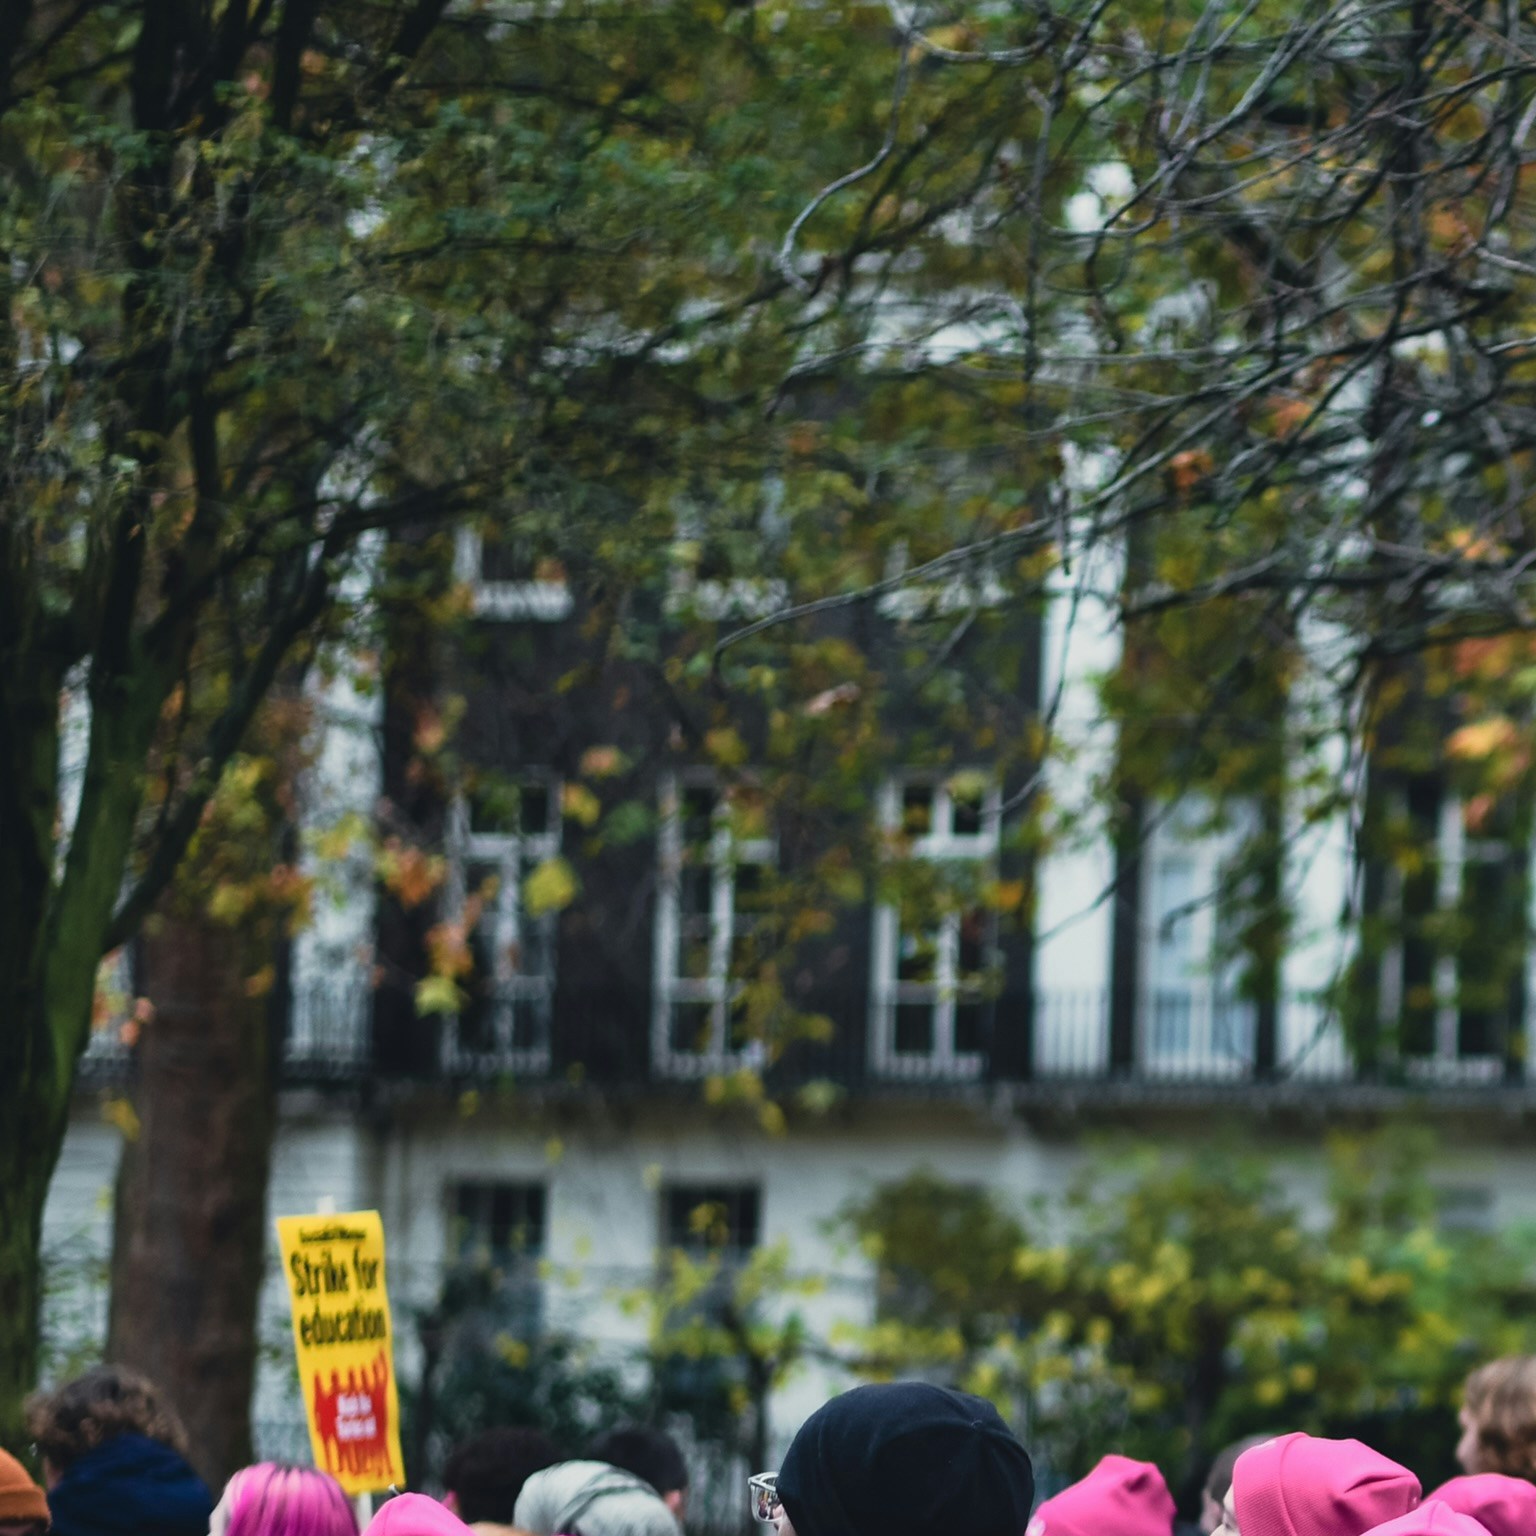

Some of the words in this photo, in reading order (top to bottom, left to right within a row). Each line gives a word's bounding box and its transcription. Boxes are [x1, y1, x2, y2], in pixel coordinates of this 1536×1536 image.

[290, 1247, 349, 1297] Strike
[353, 1243, 380, 1290] for
[300, 1297, 387, 1346] education
